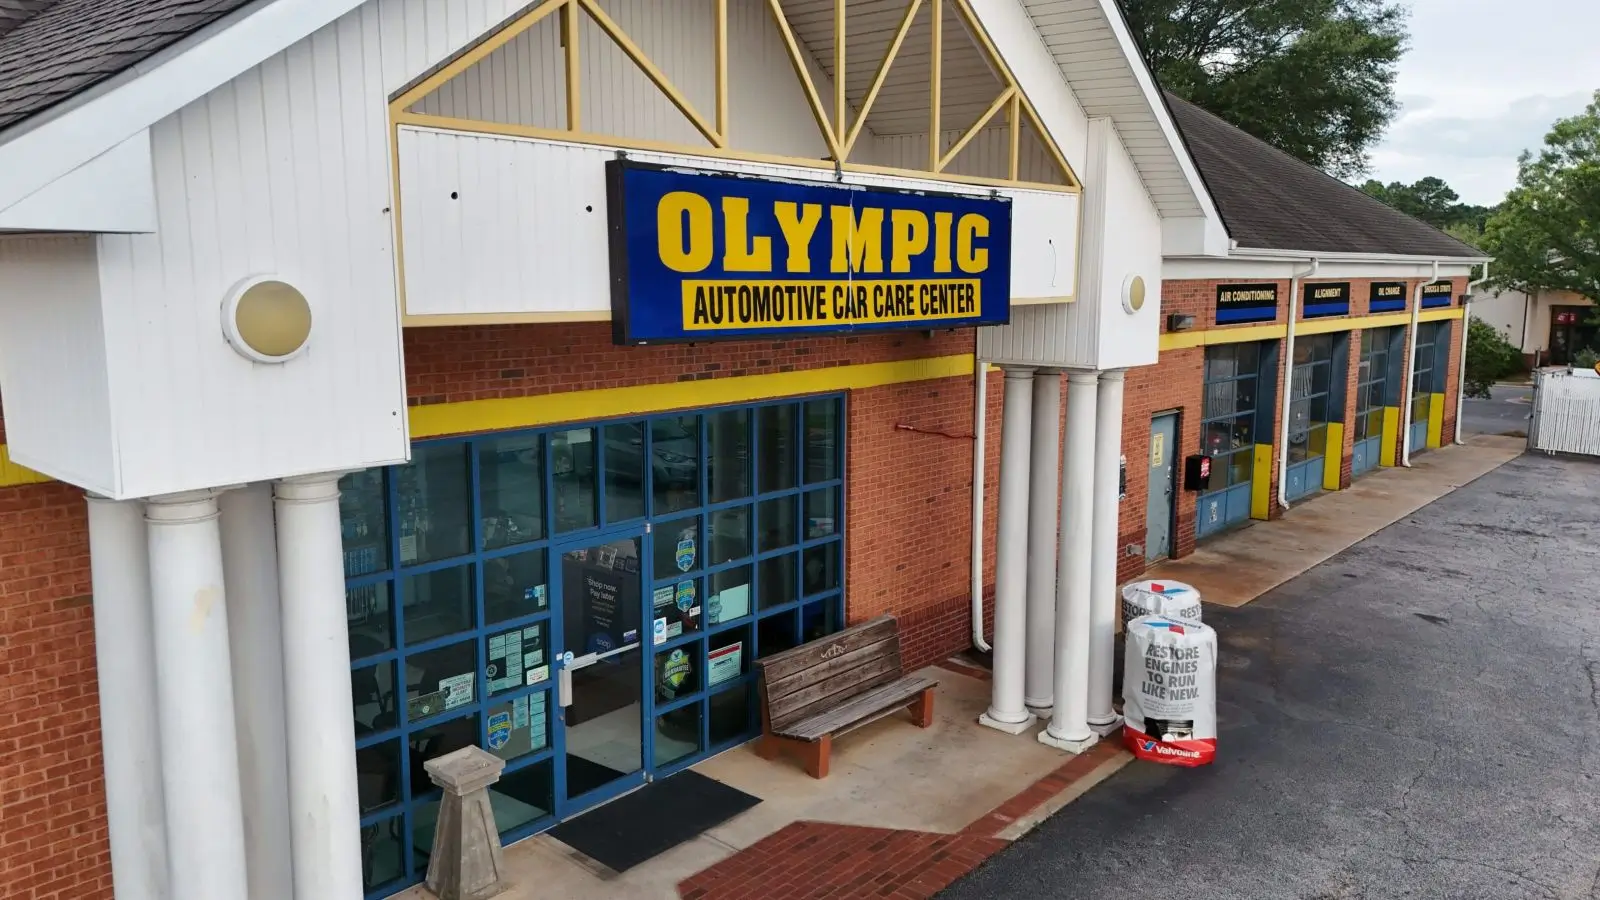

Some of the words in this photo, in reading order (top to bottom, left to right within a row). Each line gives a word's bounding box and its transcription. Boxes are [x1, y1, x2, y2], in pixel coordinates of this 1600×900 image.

[657, 191, 990, 274] OLYMPIC
[1220, 291, 1232, 302] AIR
[1232, 290, 1275, 301] CONDITIONING
[1314, 288, 1342, 299] ALIGNMENT
[1385, 286, 1401, 296] CHANGE
[693, 284, 826, 325] AUTOMOTIVE
[832, 284, 868, 320] CAR
[873, 284, 915, 317] CARE
[919, 282, 975, 315] CENTER
[588, 578, 603, 590] Shop
[603, 584, 618, 592] now.
[590, 588, 601, 600] Pay
[1145, 643, 1200, 661] RESTORE
[1145, 658, 1198, 674] ENGINES
[1147, 670, 1164, 685] TO
[1168, 674, 1196, 688] RUN
[1141, 681, 1166, 700] LIKE
[1169, 687, 1200, 701] NEW.
[1155, 745, 1200, 759] Valvoline
